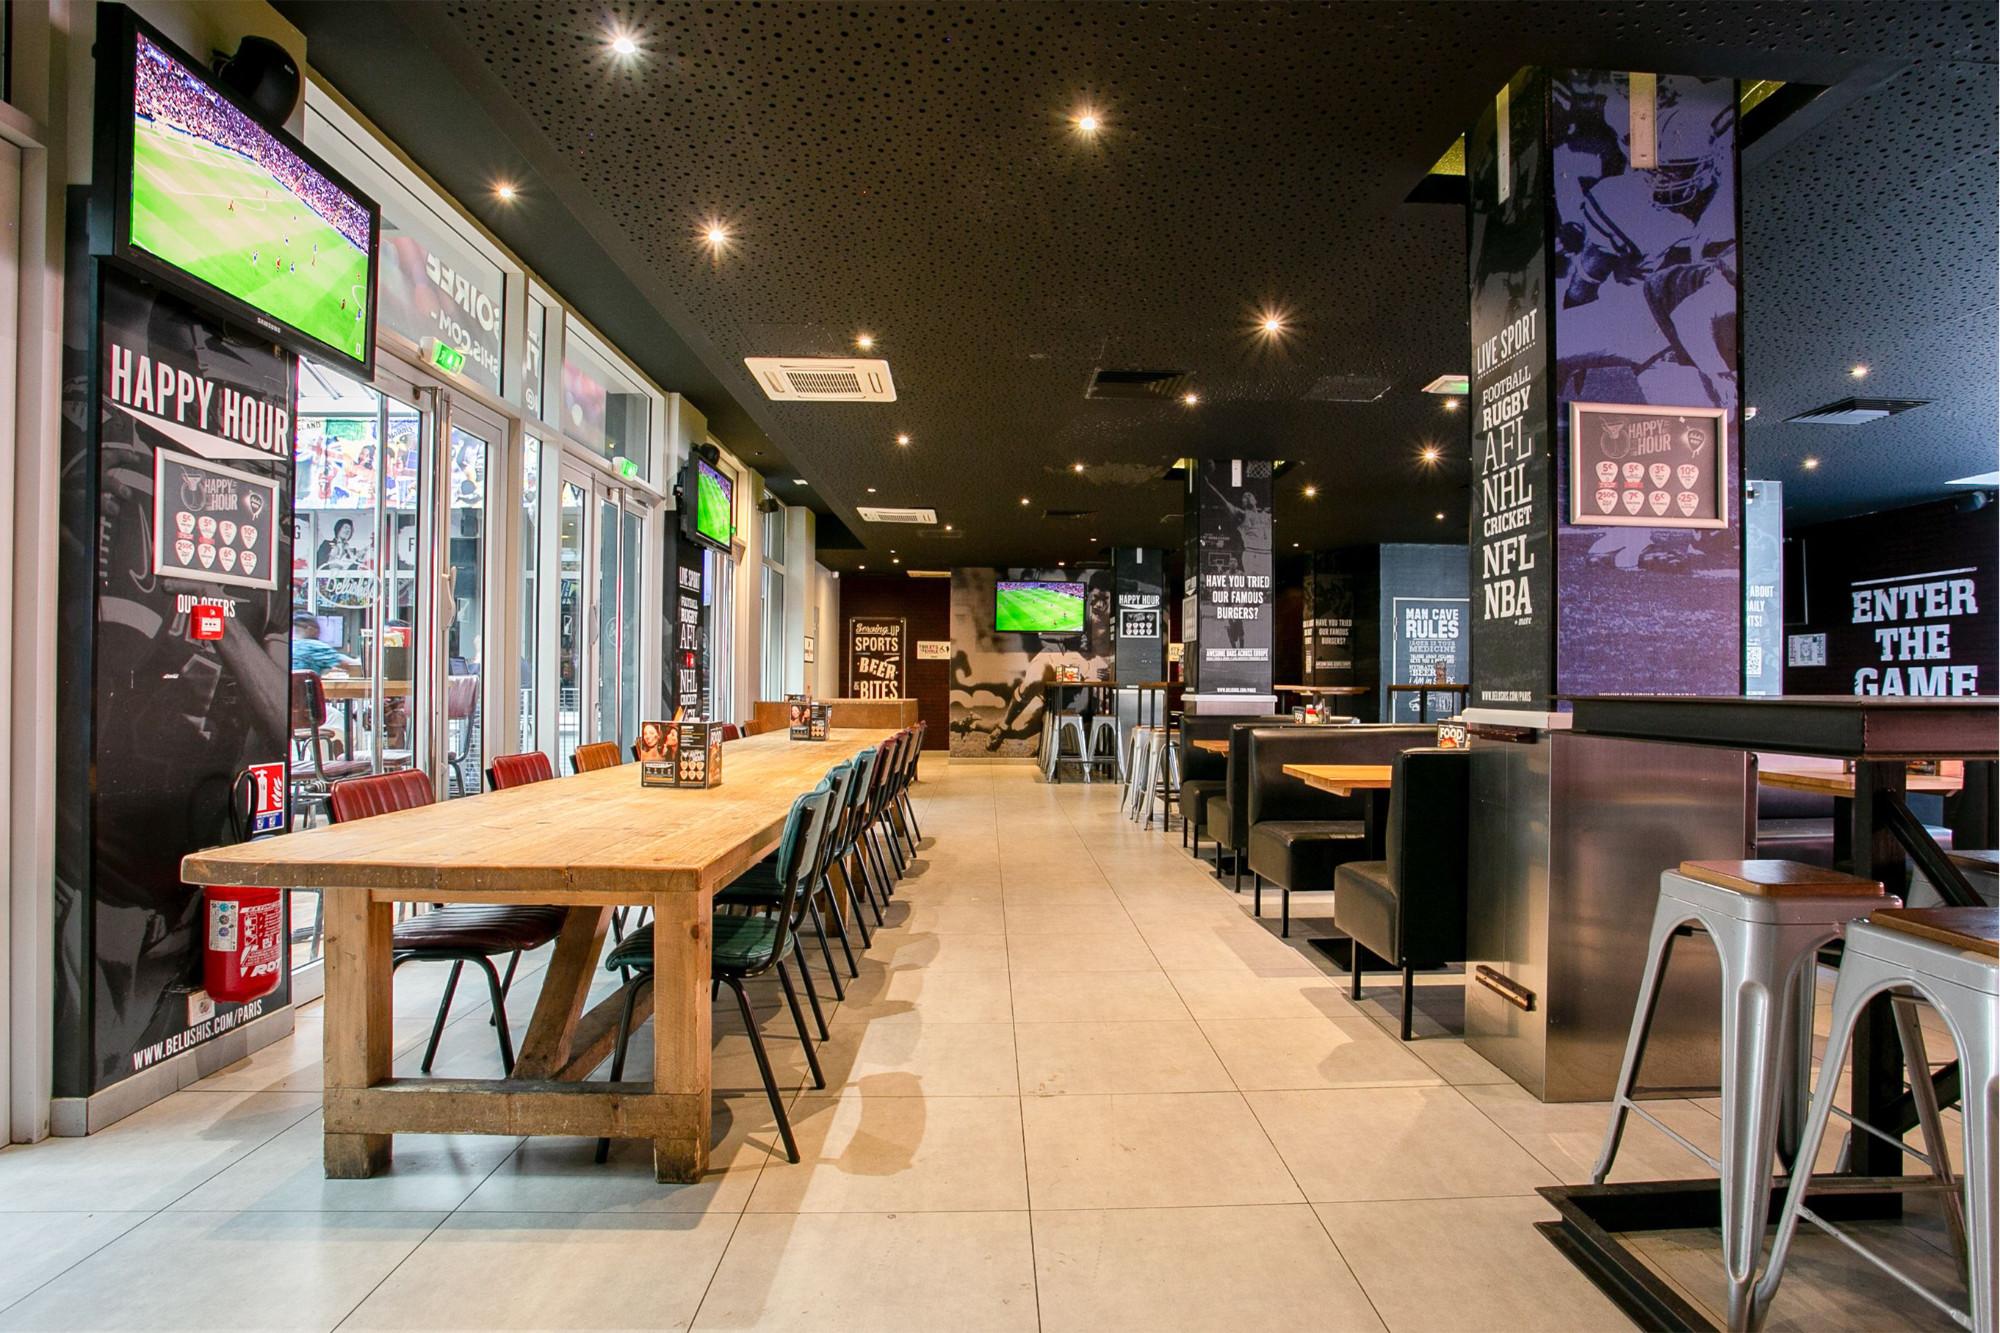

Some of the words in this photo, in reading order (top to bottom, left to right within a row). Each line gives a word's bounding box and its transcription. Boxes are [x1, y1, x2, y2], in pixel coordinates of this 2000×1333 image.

[1477, 336, 1498, 374] LIVE
[1501, 308, 1537, 359] SPORT
[1483, 365, 1531, 406] FOOTBALL
[110, 344, 214, 430] HAPPY
[221, 388, 289, 456] HOUR
[1483, 385, 1531, 431] RUGBY
[1628, 419, 1664, 438] HAPPY
[1482, 416, 1532, 475] AFL
[1637, 434, 1671, 456] HOUR
[204, 478, 232, 494] HAPPY
[1482, 463, 1532, 517] NHL
[211, 494, 238, 511] HOUR
[1484, 505, 1532, 537] CRICKET
[1483, 534, 1534, 579] NFL
[1206, 575, 1227, 587] HAVE
[1229, 576, 1245, 587] YOU
[1247, 576, 1270, 588] TRIED
[1119, 594, 1140, 605] HAPPY
[1142, 595, 1160, 605] HOUR
[1212, 591, 1229, 603] OUR
[1231, 592, 1264, 603] FAMOUS
[1484, 576, 1532, 620] NBA
[1747, 600, 1765, 612] AILY
[1852, 578, 1979, 624] ENTER
[1217, 607, 1259, 619] BURGERS?
[1406, 608, 1428, 620] MAN
[1432, 608, 1459, 620] CAVE
[680, 623, 698, 650] AFL
[890, 625, 900, 636] UP
[1406, 620, 1459, 638] RULES
[855, 637, 898, 652] SPORTS
[1875, 624, 1950, 661] THE
[859, 656, 897, 680] BEER
[680, 669, 698, 693] NHL
[860, 680, 898, 699] BITES
[1855, 665, 1978, 696] GAME
[1439, 727, 1463, 740] FOOD
[133, 999, 262, 1070] WWW.BELUSHIS.COM/PARIS
